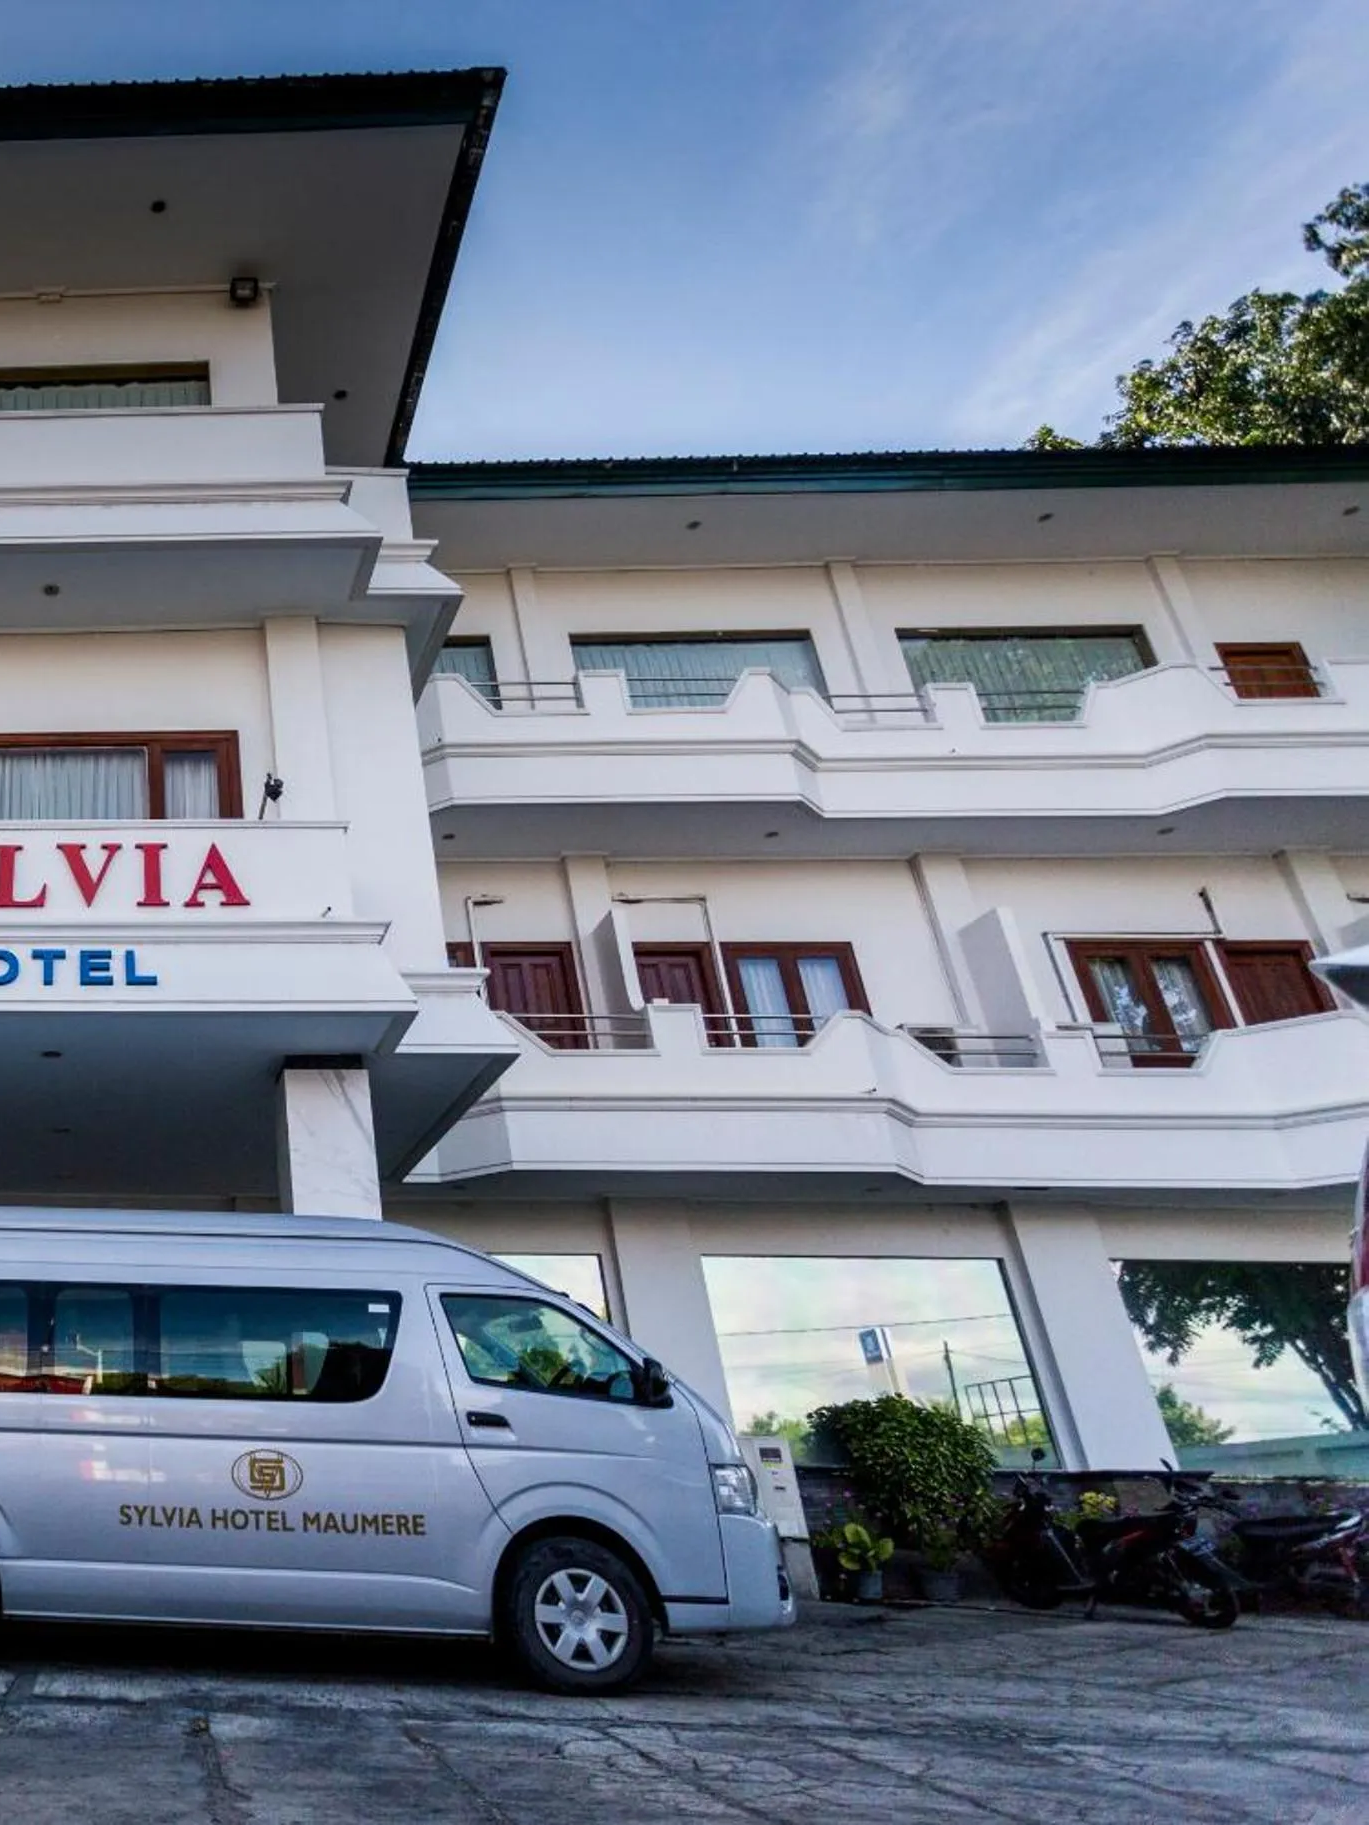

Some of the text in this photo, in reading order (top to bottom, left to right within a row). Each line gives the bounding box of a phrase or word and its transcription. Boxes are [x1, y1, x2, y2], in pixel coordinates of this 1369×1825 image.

[119, 1504, 426, 1536] SYLVIA HOTEL MAUMERE
